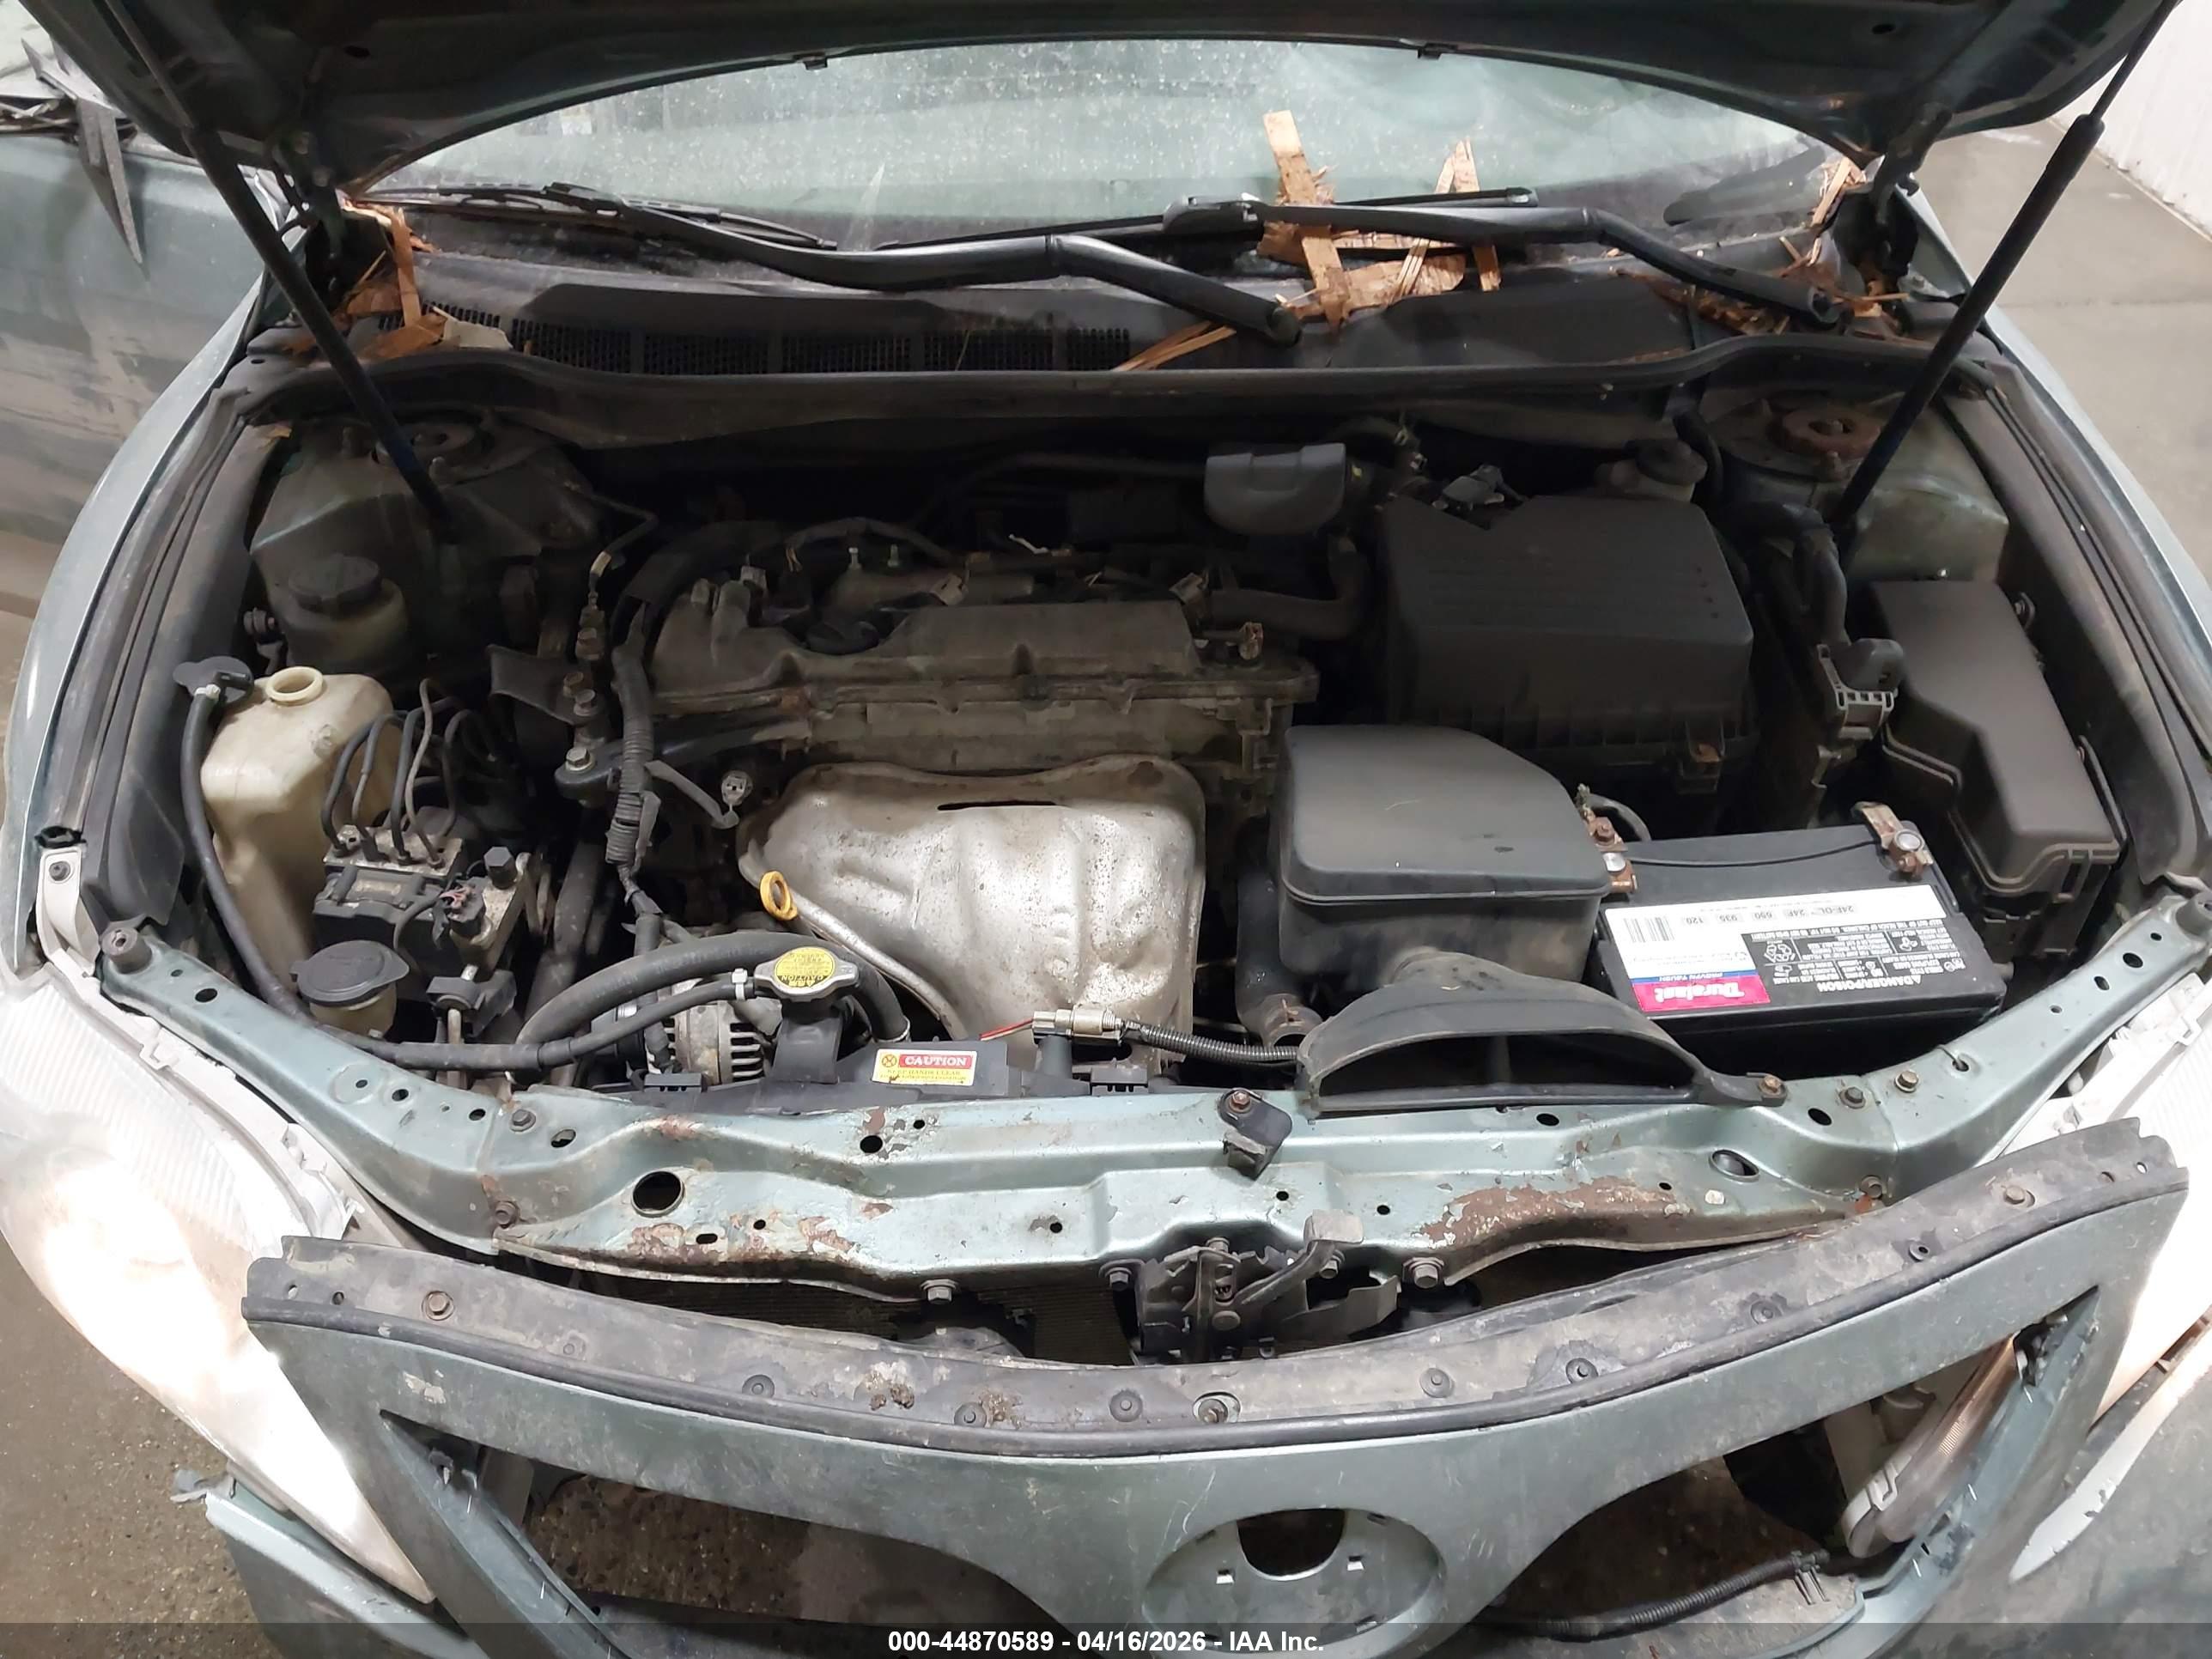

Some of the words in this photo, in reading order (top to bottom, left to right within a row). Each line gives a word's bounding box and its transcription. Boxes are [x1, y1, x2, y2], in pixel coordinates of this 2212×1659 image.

[1686, 916, 1704, 925] 120
[1654, 981, 1745, 1003] Duralast
[904, 1055, 968, 1066] CAUTION
